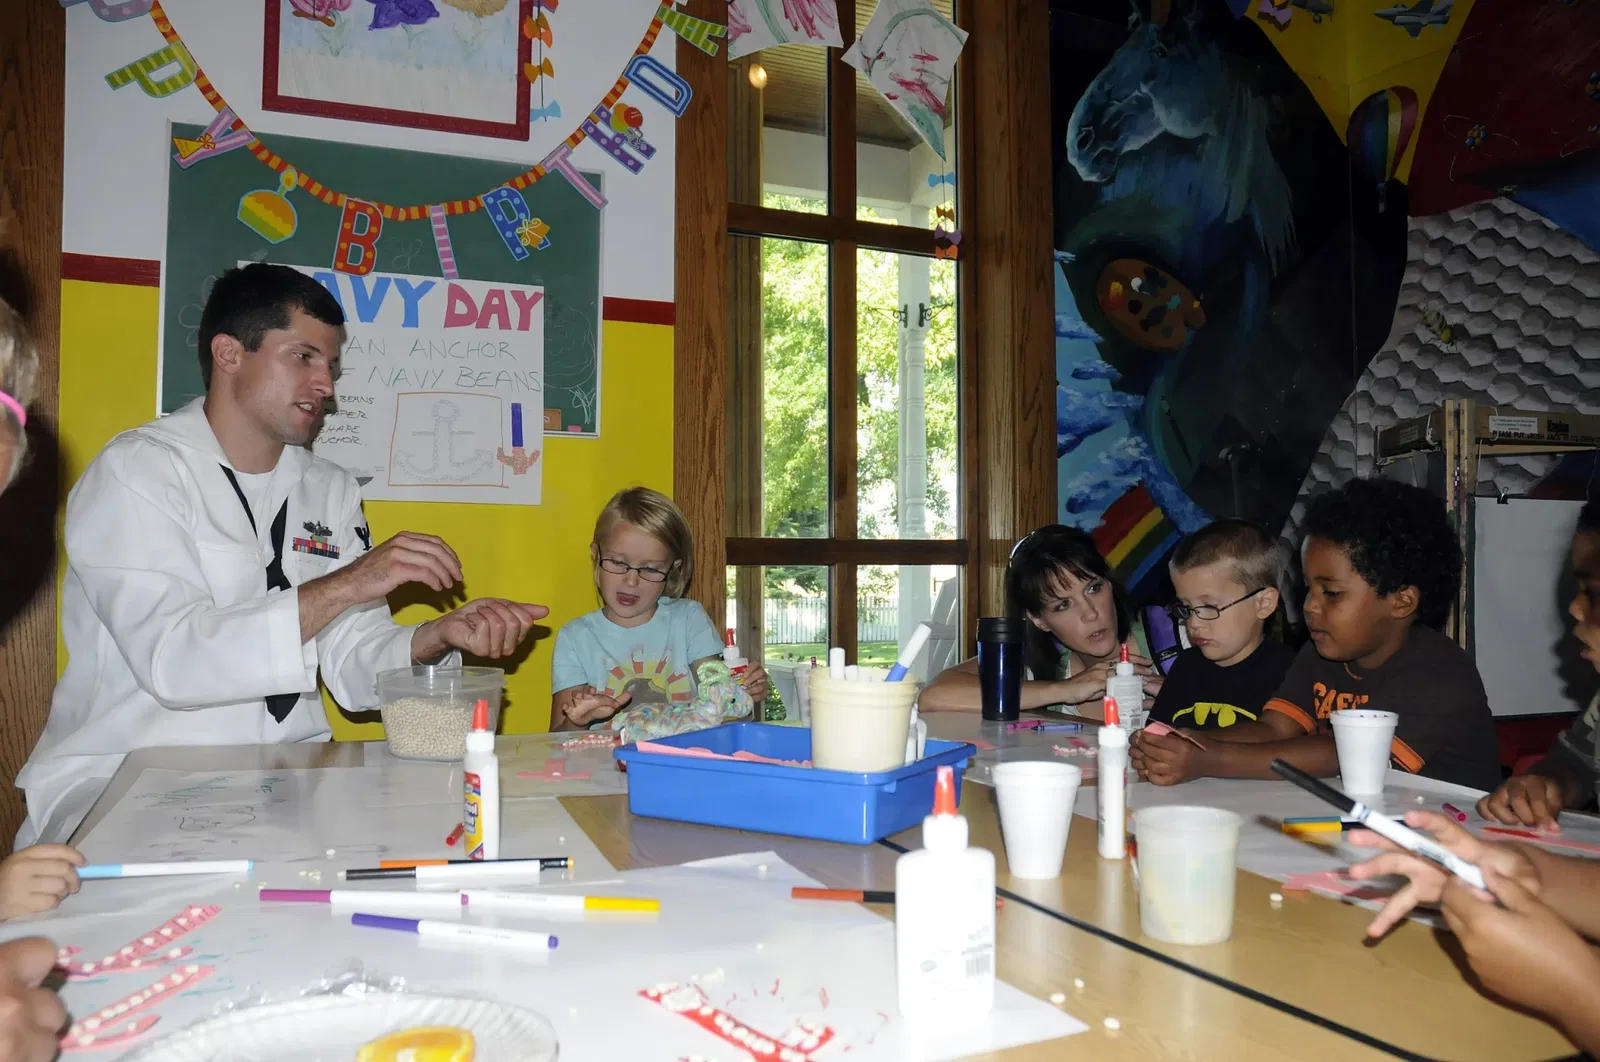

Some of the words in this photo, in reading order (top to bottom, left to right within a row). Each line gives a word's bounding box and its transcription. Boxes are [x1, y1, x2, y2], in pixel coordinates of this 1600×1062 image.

[312, 271, 436, 329] AVY
[443, 282, 544, 332] DAY
[345, 335, 386, 356] AN
[409, 338, 517, 361] ANCHOR
[368, 365, 445, 389] NAVY
[454, 365, 542, 392] BEANS
[339, 395, 375, 405] BEANS
